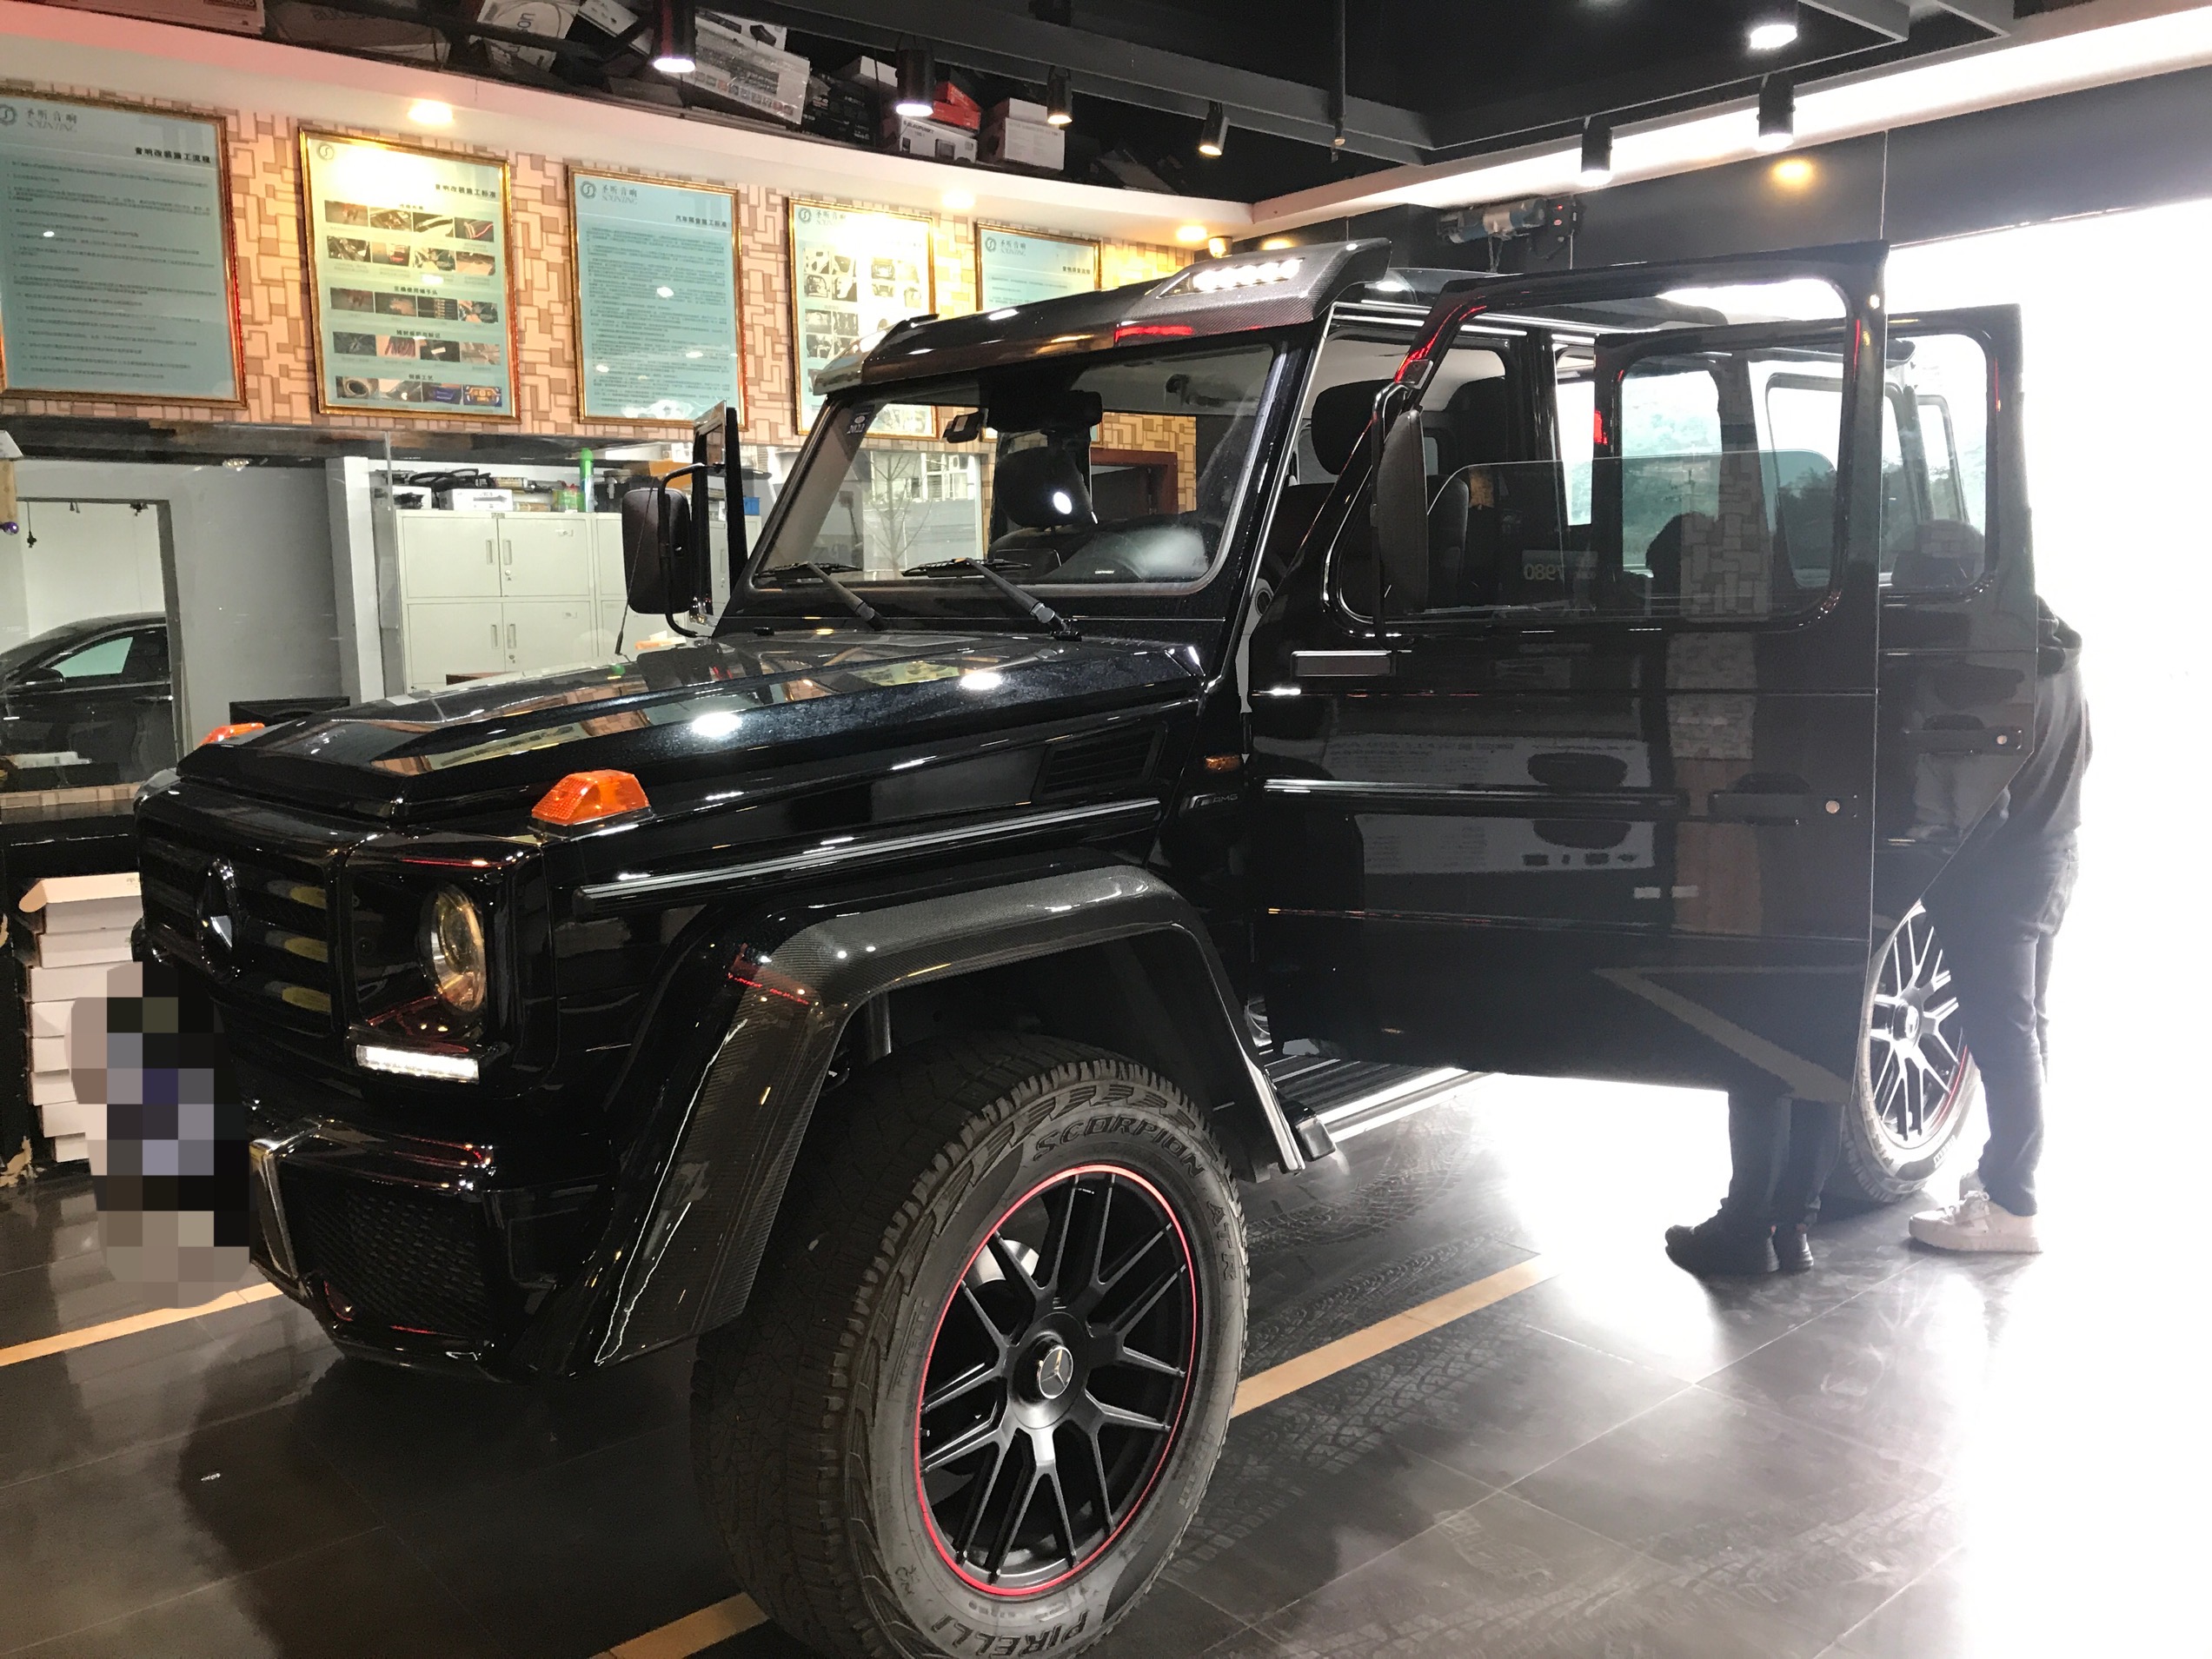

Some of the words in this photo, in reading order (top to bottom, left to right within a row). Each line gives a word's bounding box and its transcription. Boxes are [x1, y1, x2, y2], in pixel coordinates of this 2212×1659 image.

[1212, 793, 1239, 804] AMG
[1033, 1114, 1205, 1178] SCORPION
[1206, 1201, 1239, 1282] ATR
[931, 1610, 1089, 1659] PIRELLI
